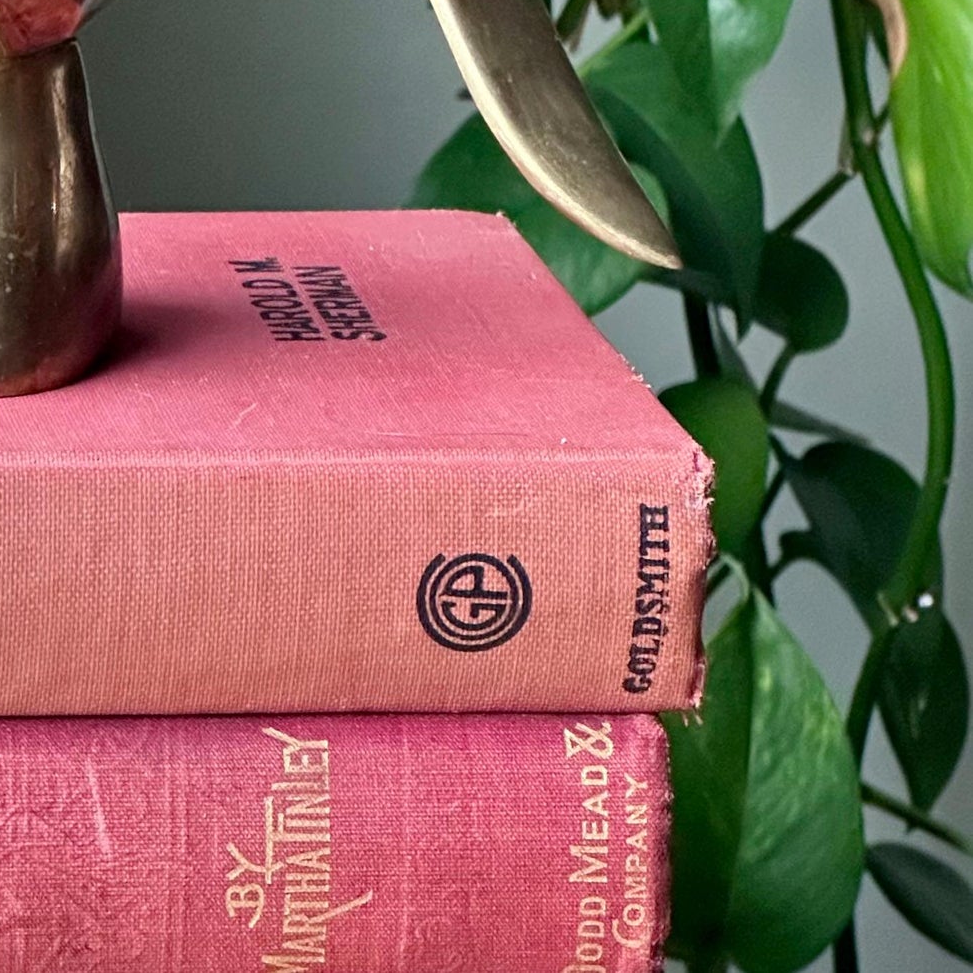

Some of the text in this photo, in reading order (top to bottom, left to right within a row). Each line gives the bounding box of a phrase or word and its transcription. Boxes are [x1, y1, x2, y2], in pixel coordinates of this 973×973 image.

[242, 279, 326, 342] HAROLD
[291, 266, 388, 342] SHERMAN
[622, 502, 670, 694] GOLDSMITH
[563, 721, 614, 760] &
[568, 765, 610, 884] MEAD
[611, 772, 649, 948] COMPANY
[227, 842, 285, 929] BY
